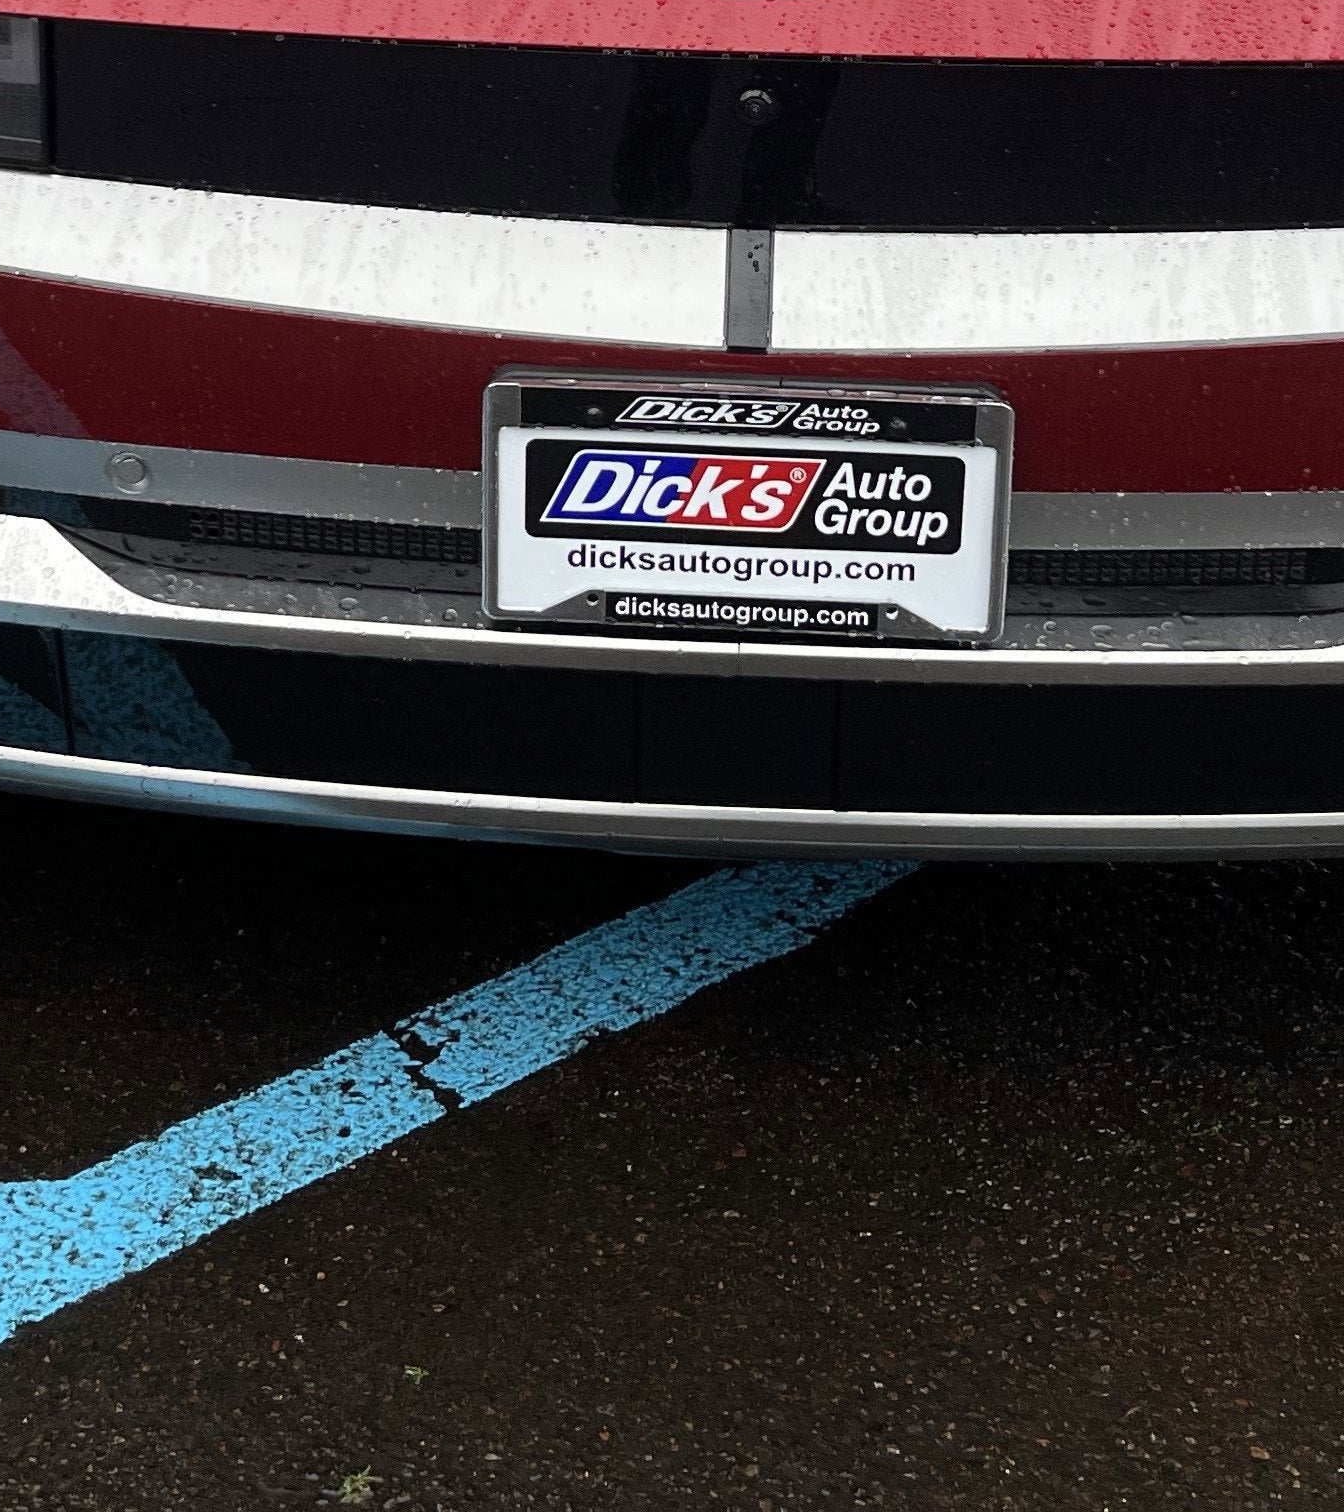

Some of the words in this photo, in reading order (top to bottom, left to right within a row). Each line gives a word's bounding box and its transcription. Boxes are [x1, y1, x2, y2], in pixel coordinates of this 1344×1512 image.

[630, 400, 779, 425] Dick's
[792, 418, 881, 436] Group
[799, 403, 869, 420] Auto
[561, 459, 793, 523] Dick's
[821, 462, 932, 503] Auto
[813, 498, 949, 545] Group
[566, 544, 916, 583] dicksautogroup.com
[615, 596, 869, 627] dicksautogroup.com
